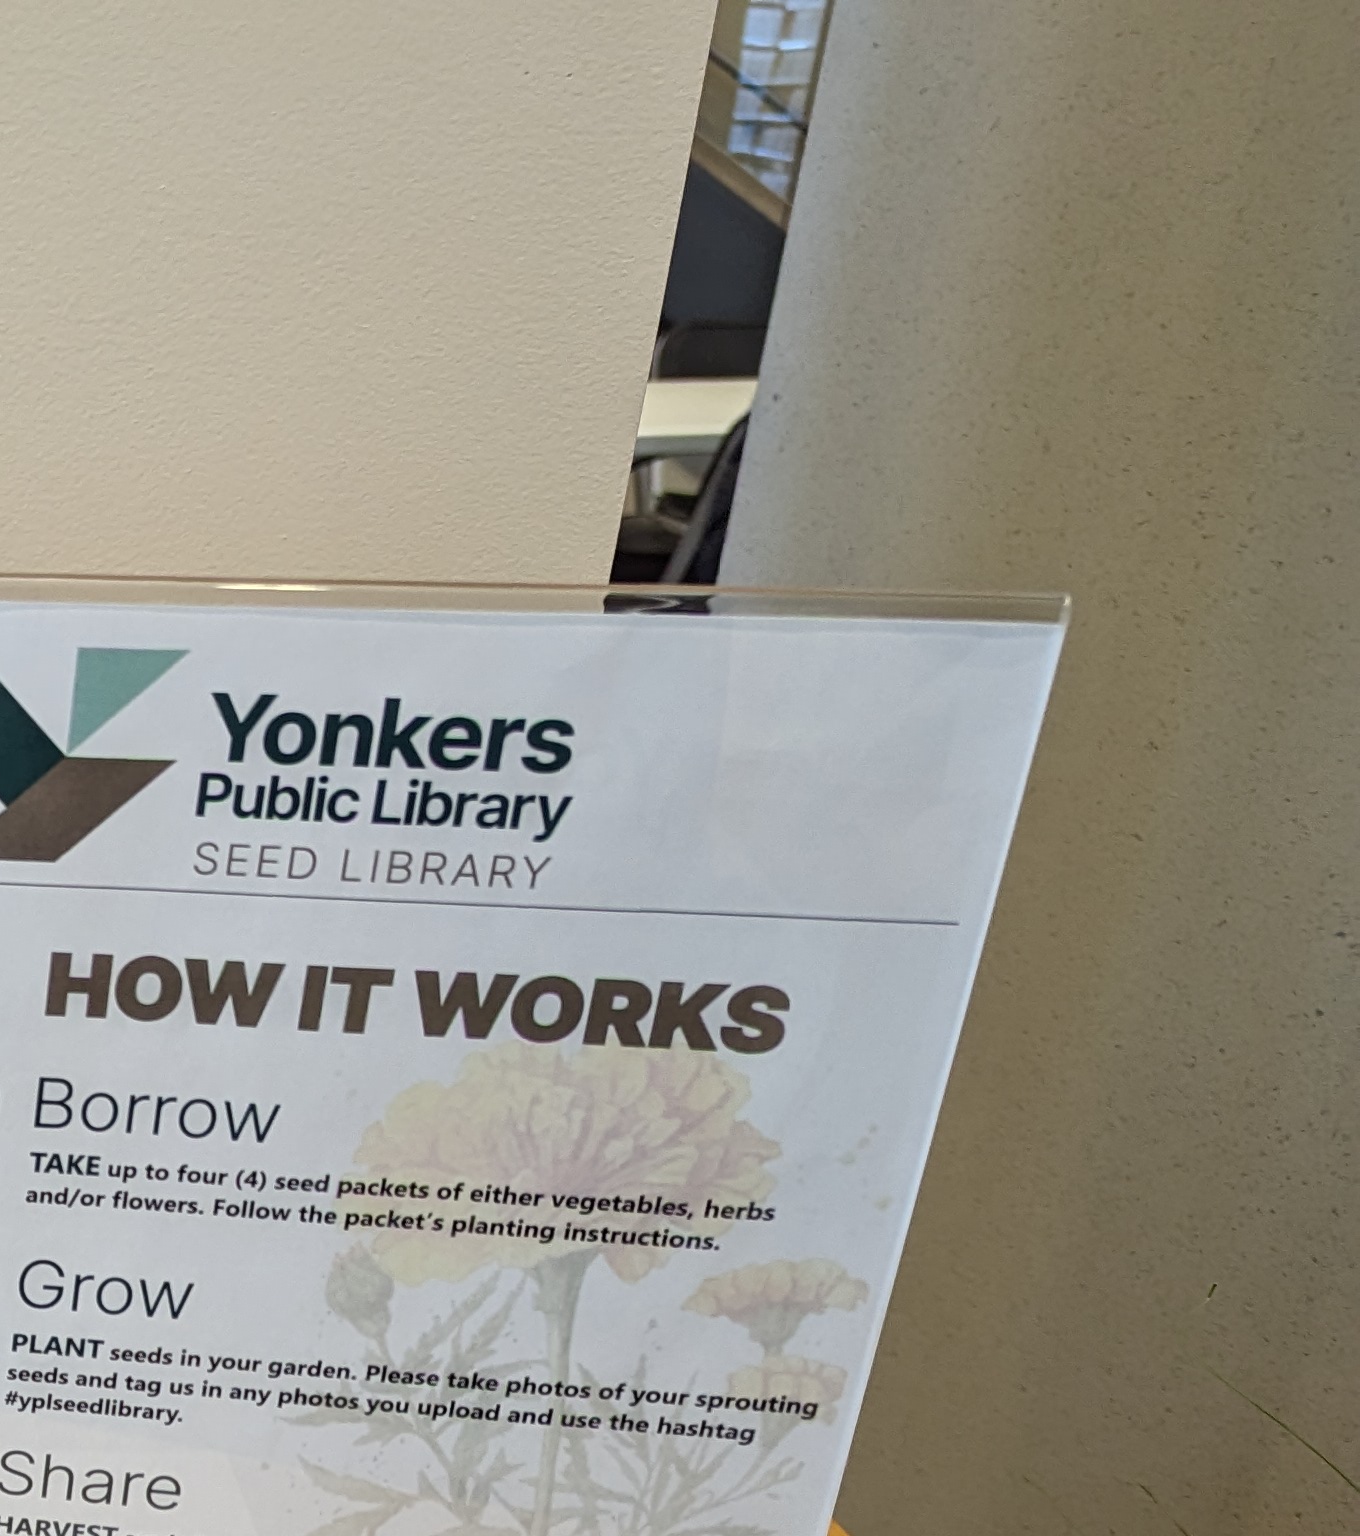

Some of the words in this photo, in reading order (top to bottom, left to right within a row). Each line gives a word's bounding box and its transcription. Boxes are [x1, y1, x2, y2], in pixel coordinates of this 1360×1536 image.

[211, 692, 575, 774] Yonkers
[195, 772, 360, 824] Public
[371, 778, 573, 843] Library
[193, 841, 318, 880] SEED
[340, 848, 552, 890] LIBRARY
[44, 951, 287, 1028] HOW
[297, 965, 396, 1035] IT
[414, 969, 791, 1055] WORKS
[33, 1076, 281, 1144] Borrow
[25, 1186, 106, 1208] and/or
[112, 1190, 204, 1215] flowers.
[212, 1198, 292, 1221] Follow
[298, 1204, 337, 1225] the
[450, 1215, 556, 1245] planting
[563, 1222, 720, 1251] instructions.
[29, 1151, 101, 1177] TAKE
[107, 1164, 138, 1184] up
[144, 1164, 170, 1181] to
[177, 1164, 229, 1186] four
[235, 1169, 267, 1192] (4)
[273, 1174, 331, 1193] seed
[336, 1177, 430, 1199] packets
[436, 1182, 465, 1201] of
[470, 1184, 545, 1207] either
[551, 1194, 693, 1221] vegetables,
[704, 1198, 775, 1222] herbs
[18, 1259, 195, 1320] Grow
[4, 1390, 183, 1426] #yplseedlibrary.
[11, 1333, 105, 1359] PLANT
[109, 1347, 173, 1366] seeds
[180, 1348, 201, 1368] in
[206, 1356, 262, 1373] your
[267, 1359, 356, 1380] garden.
[365, 1364, 440, 1387] Please
[446, 1371, 499, 1392] take
[504, 1376, 591, 1399] photos
[598, 1382, 627, 1401] of
[628, 1389, 690, 1407] your
[694, 1394, 819, 1421] sprouting
